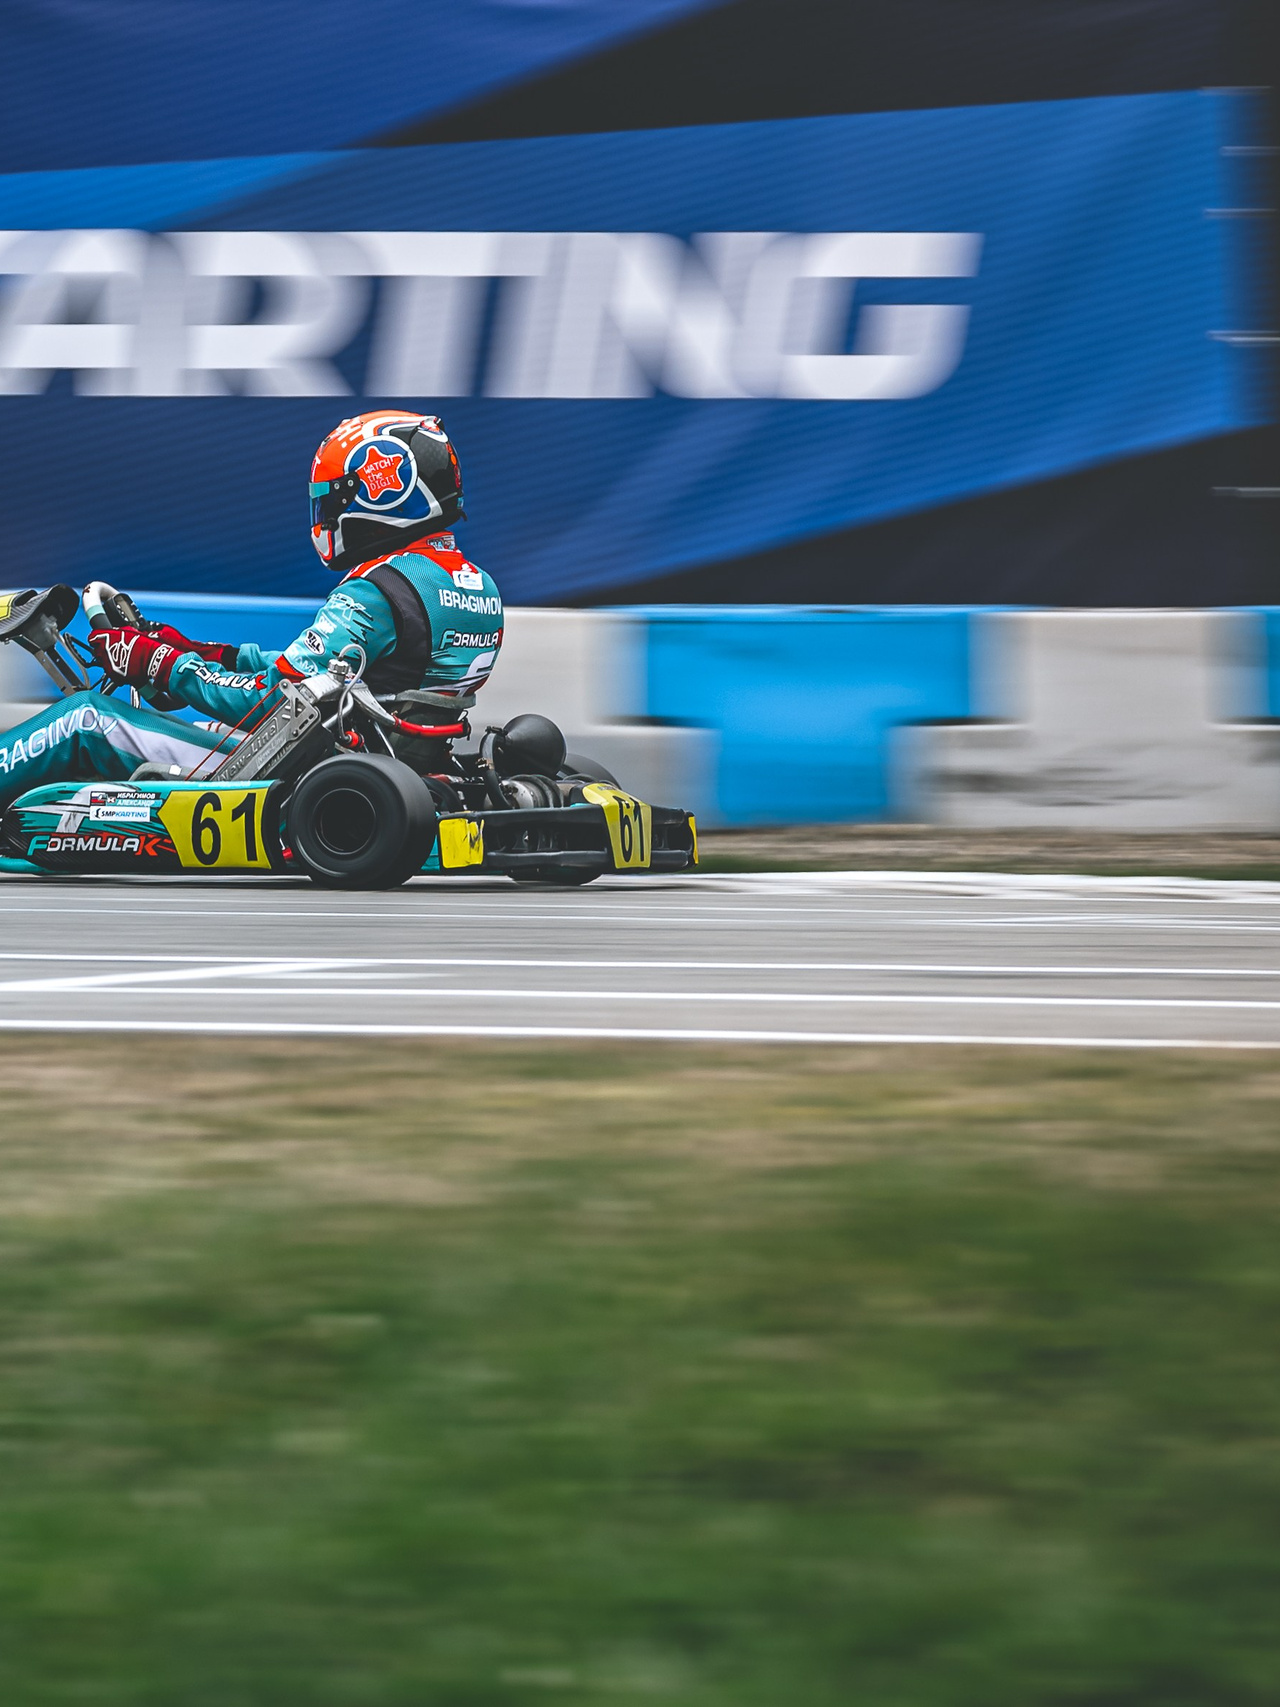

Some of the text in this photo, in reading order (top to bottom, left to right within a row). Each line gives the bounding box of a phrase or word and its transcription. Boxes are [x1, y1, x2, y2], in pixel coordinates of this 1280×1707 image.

[363, 457, 395, 475] WATCH!
[368, 472, 383, 483] the
[370, 474, 396, 491] DIGIT
[191, 791, 259, 866] 61
[612, 795, 645, 863] 61
